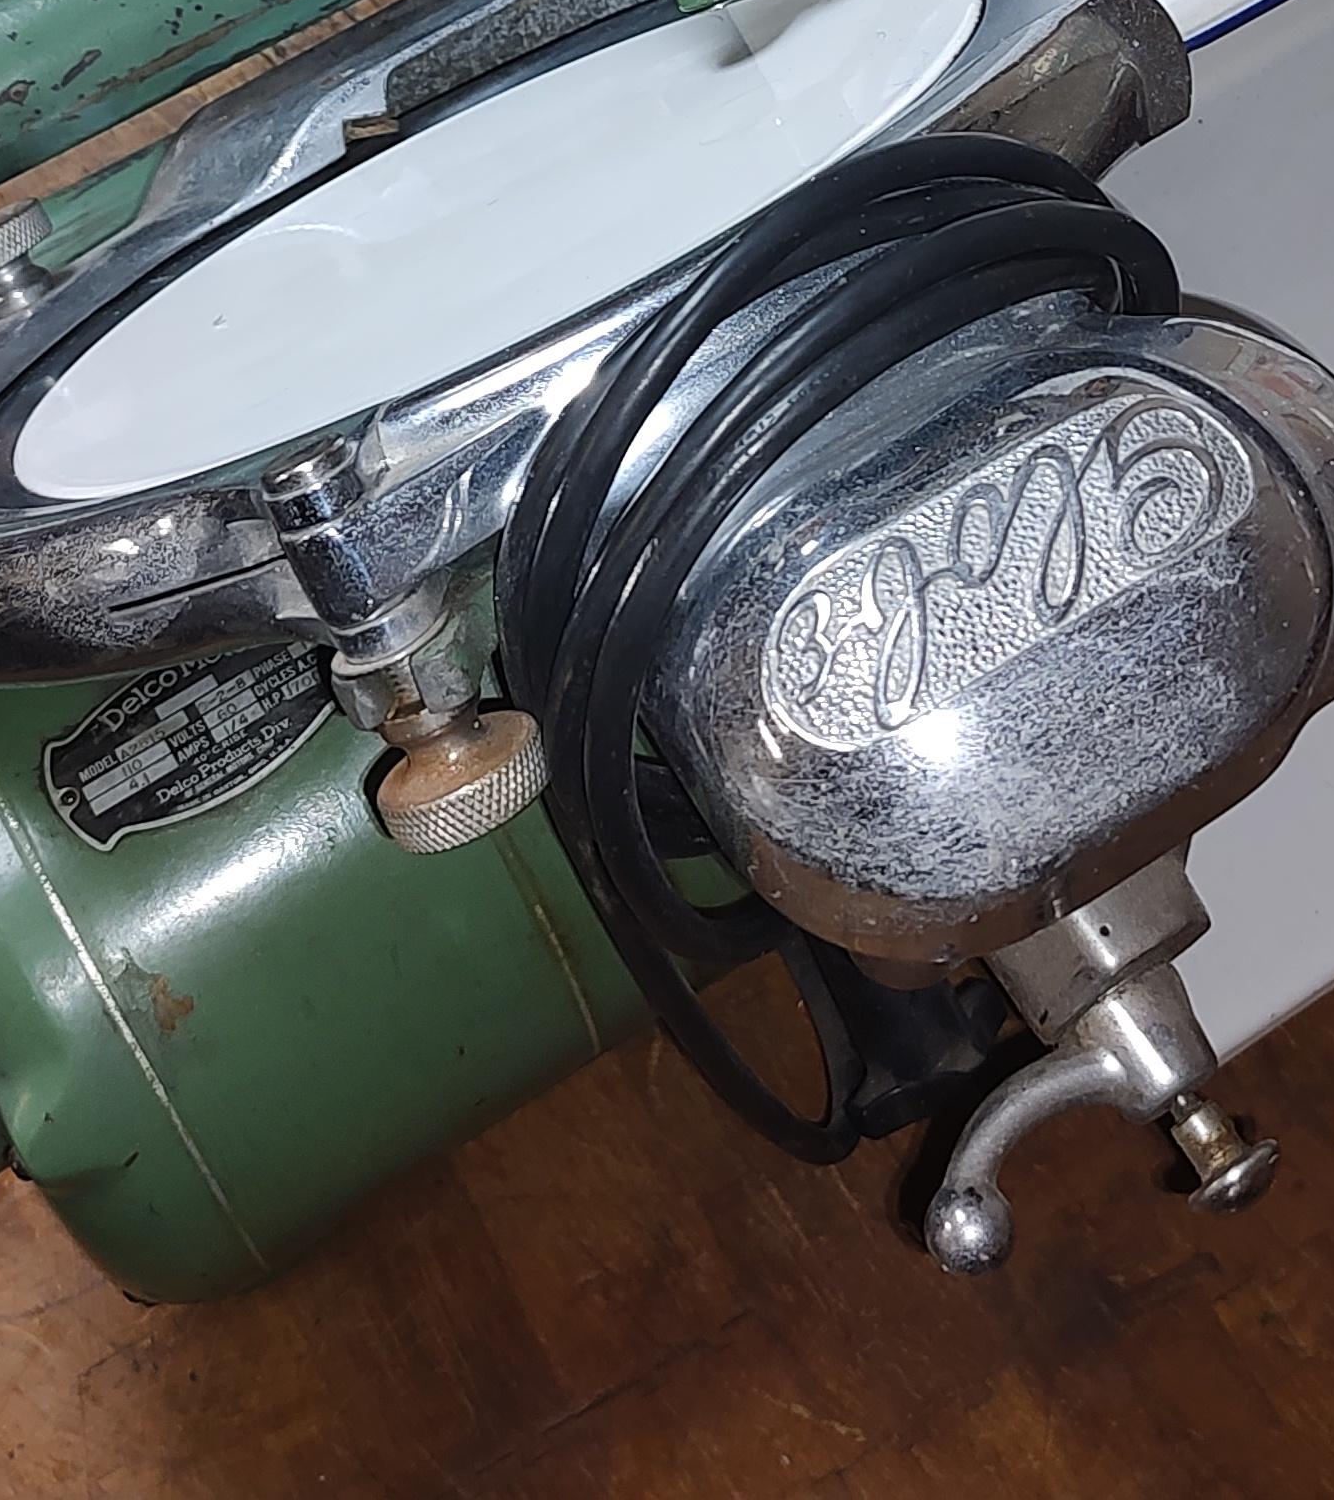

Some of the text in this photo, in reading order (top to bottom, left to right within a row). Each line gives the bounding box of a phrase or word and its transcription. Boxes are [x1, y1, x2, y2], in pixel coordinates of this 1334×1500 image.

[771, 396, 1222, 729] Globe
[251, 649, 290, 679] PHASE
[253, 664, 297, 697] CYCLES
[97, 667, 180, 732] Delco
[168, 719, 206, 748] VOLTS
[222, 712, 249, 734] 1/4
[156, 714, 293, 804] Delco Products Div.
[175, 734, 211, 763] AMPS
[77, 752, 118, 783] MODEL
[120, 757, 143, 777] 110
[126, 772, 151, 792] 4.1
